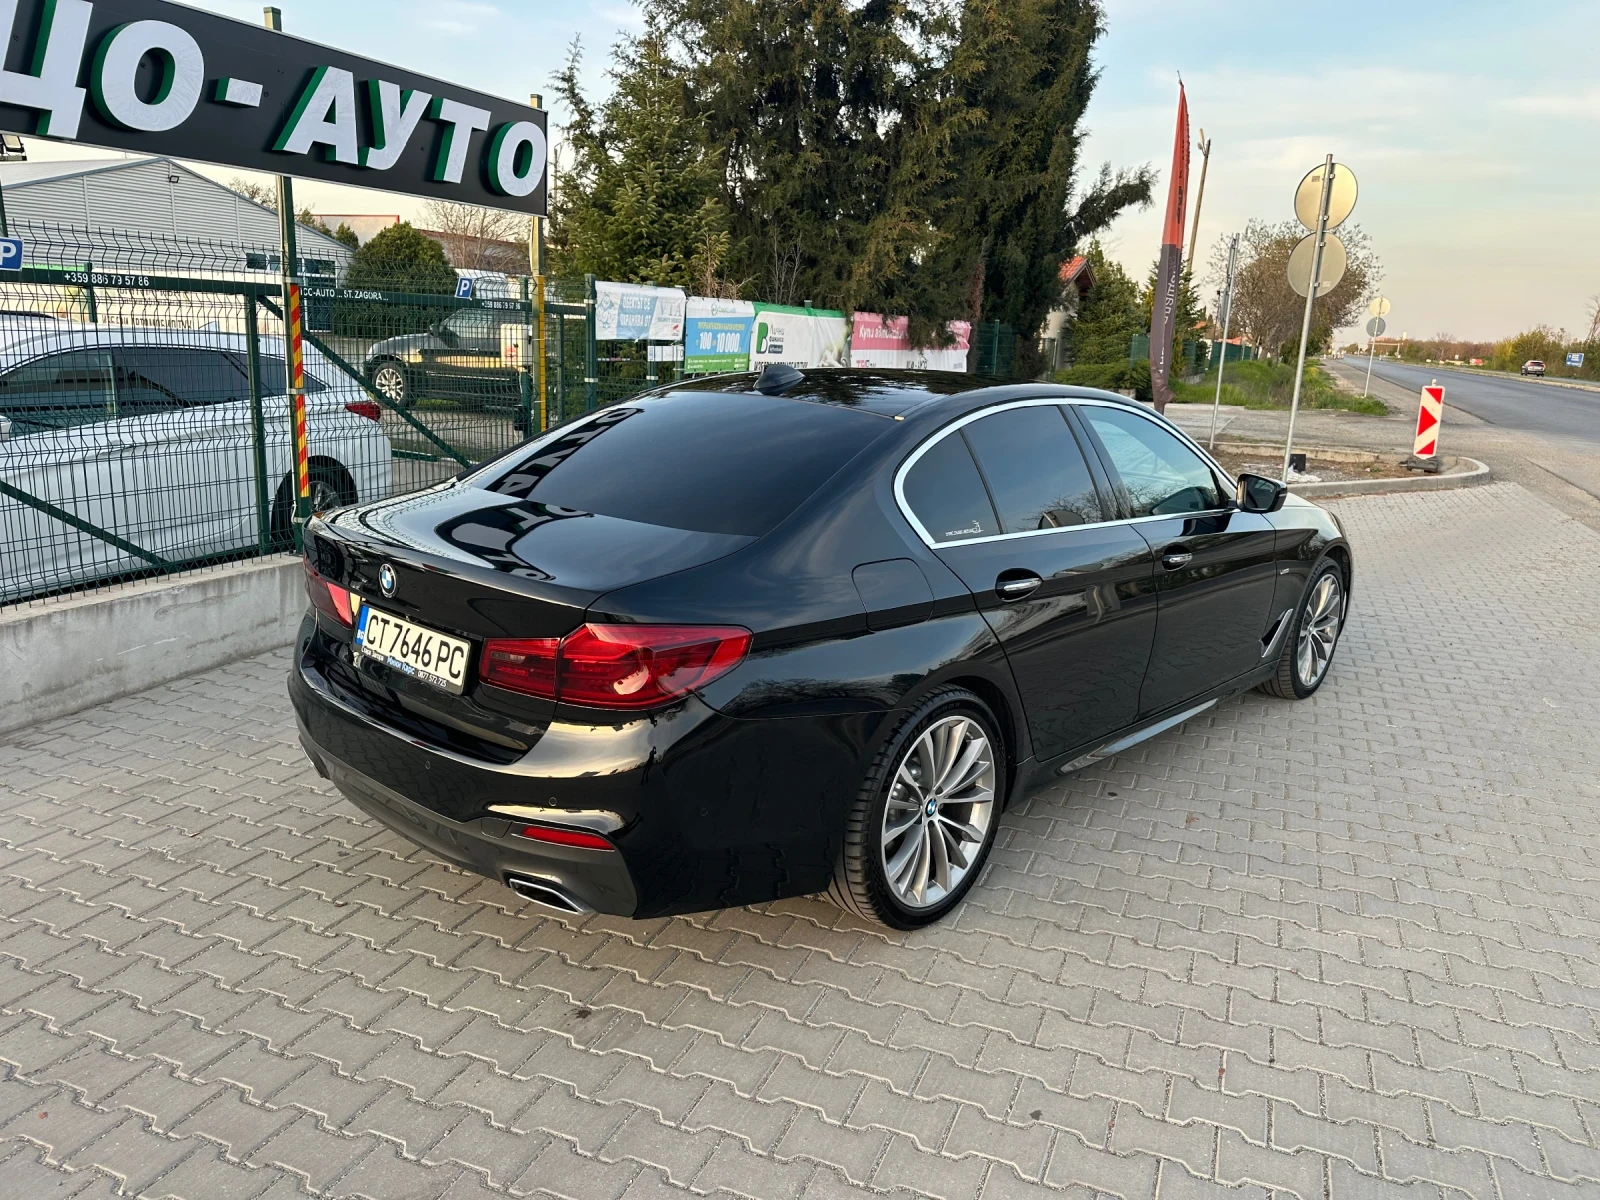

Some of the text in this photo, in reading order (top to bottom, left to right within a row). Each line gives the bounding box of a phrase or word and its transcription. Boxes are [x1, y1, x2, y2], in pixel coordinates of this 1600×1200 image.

[64, 272, 149, 287] +359 886 79 57 86
[354, 290, 382, 300] ZAGORA
[460, 280, 470, 296] P
[700, 331, 712, 350] 100
